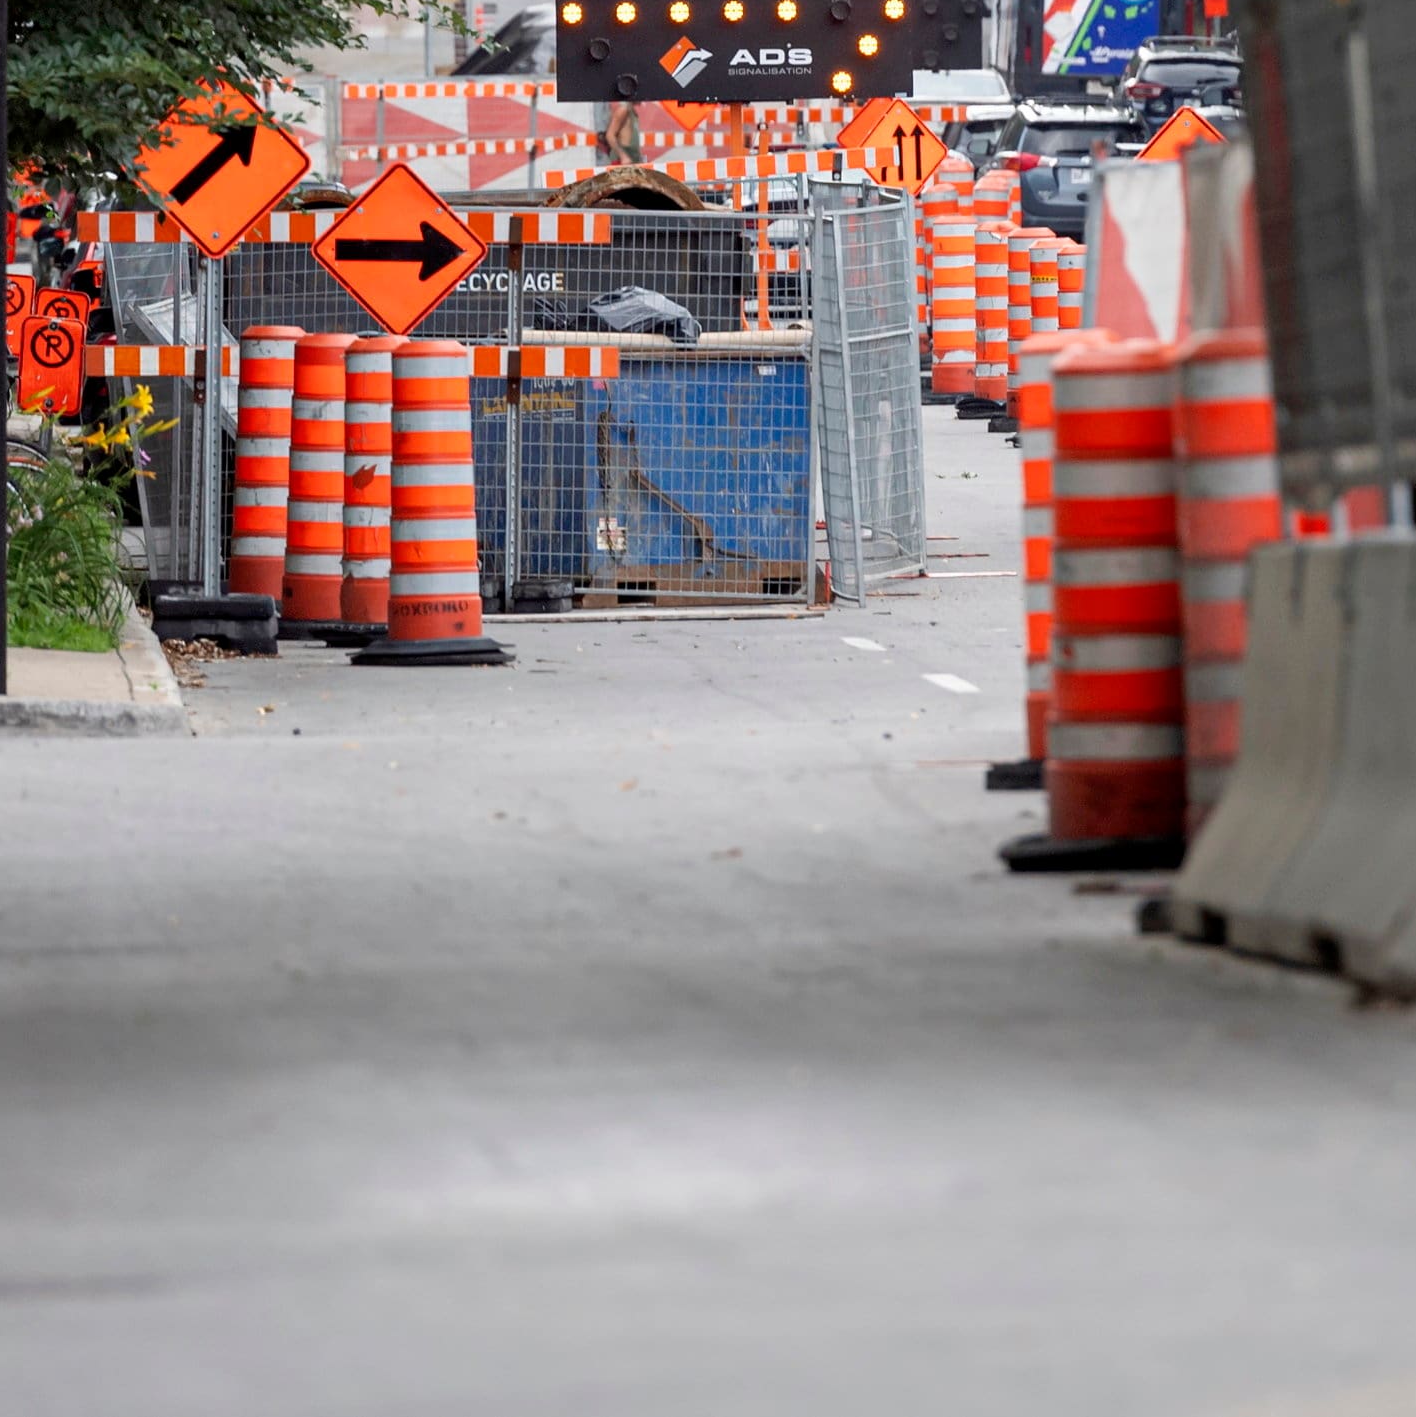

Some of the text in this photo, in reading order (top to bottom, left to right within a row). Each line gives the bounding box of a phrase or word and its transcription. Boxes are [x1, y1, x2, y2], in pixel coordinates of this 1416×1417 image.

[729, 48, 813, 66] ADS
[728, 67, 813, 76] SIGNALISATION
[456, 272, 565, 292] ECYCAGE
